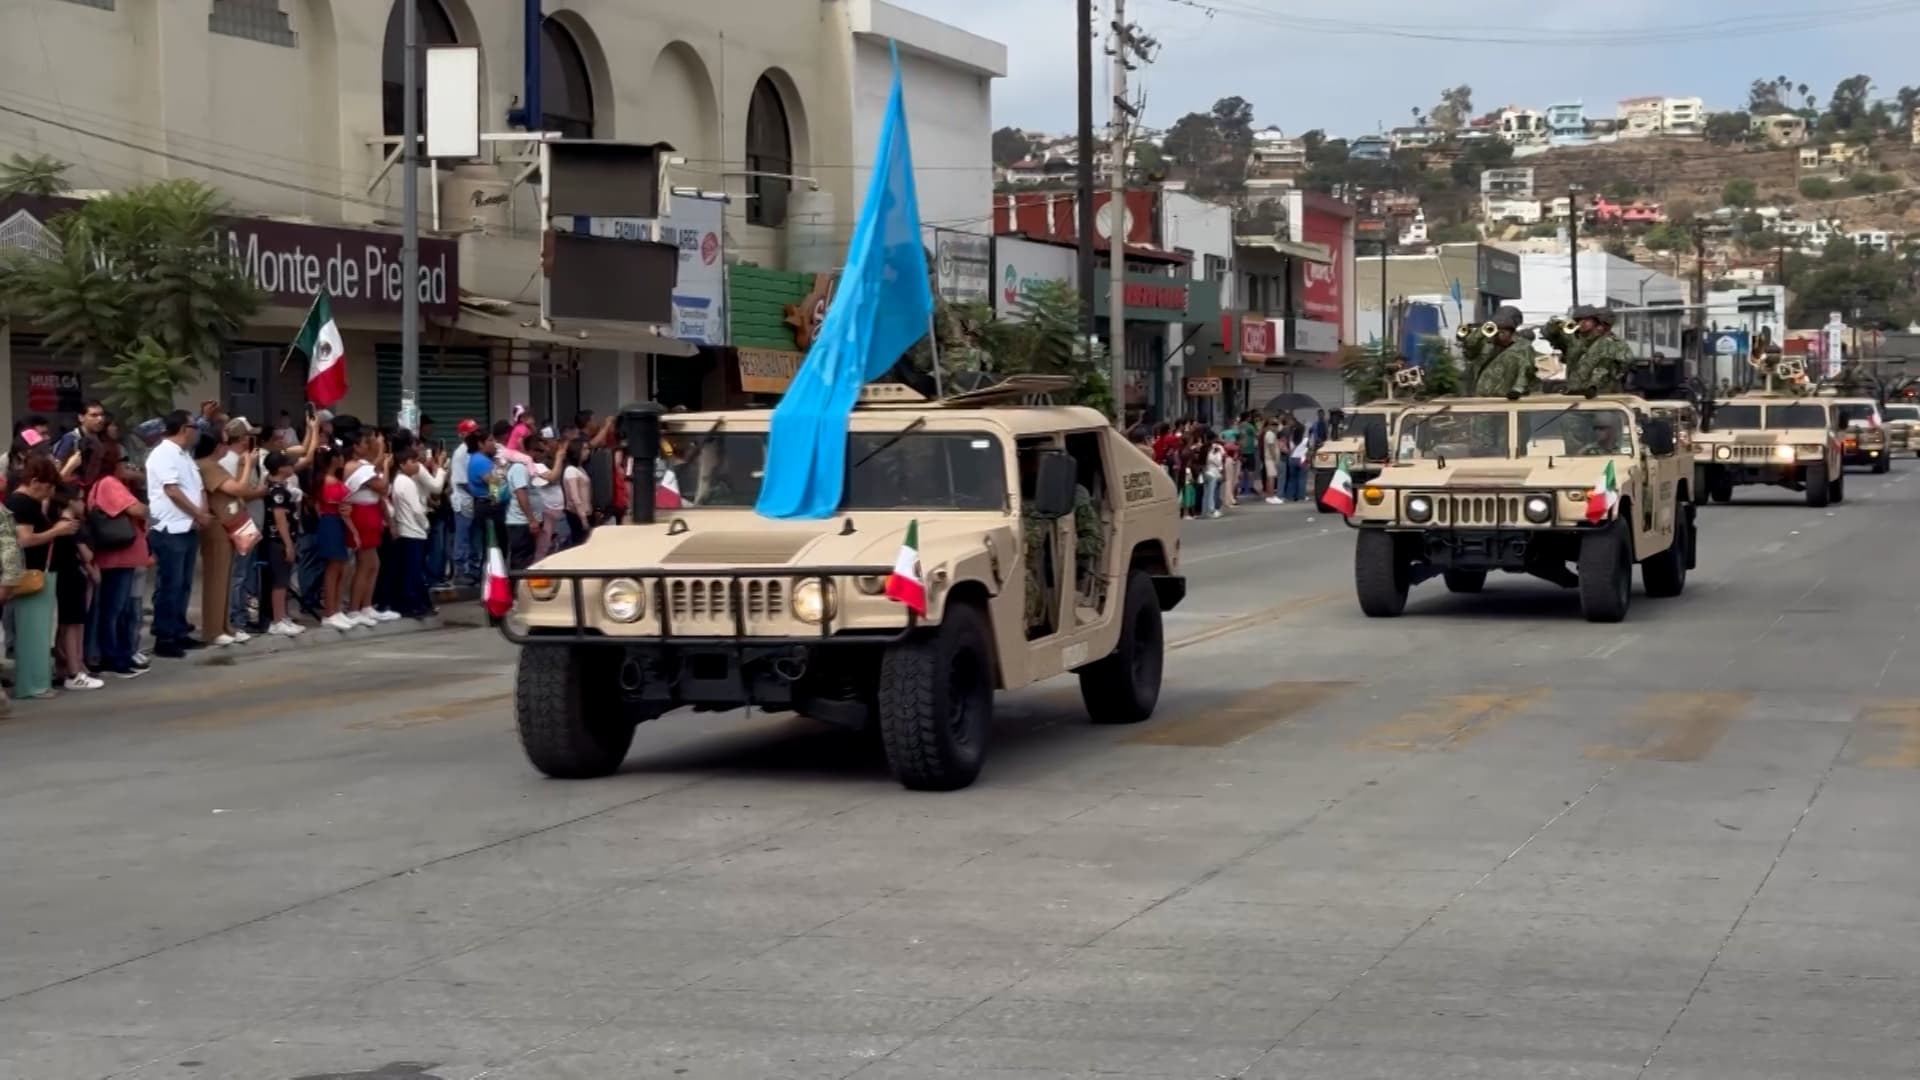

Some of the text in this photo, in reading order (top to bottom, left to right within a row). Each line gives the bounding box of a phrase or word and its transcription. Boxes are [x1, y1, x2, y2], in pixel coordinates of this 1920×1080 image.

[228, 231, 320, 294] Monte
[327, 242, 359, 298] de
[365, 245, 446, 304] Piead
